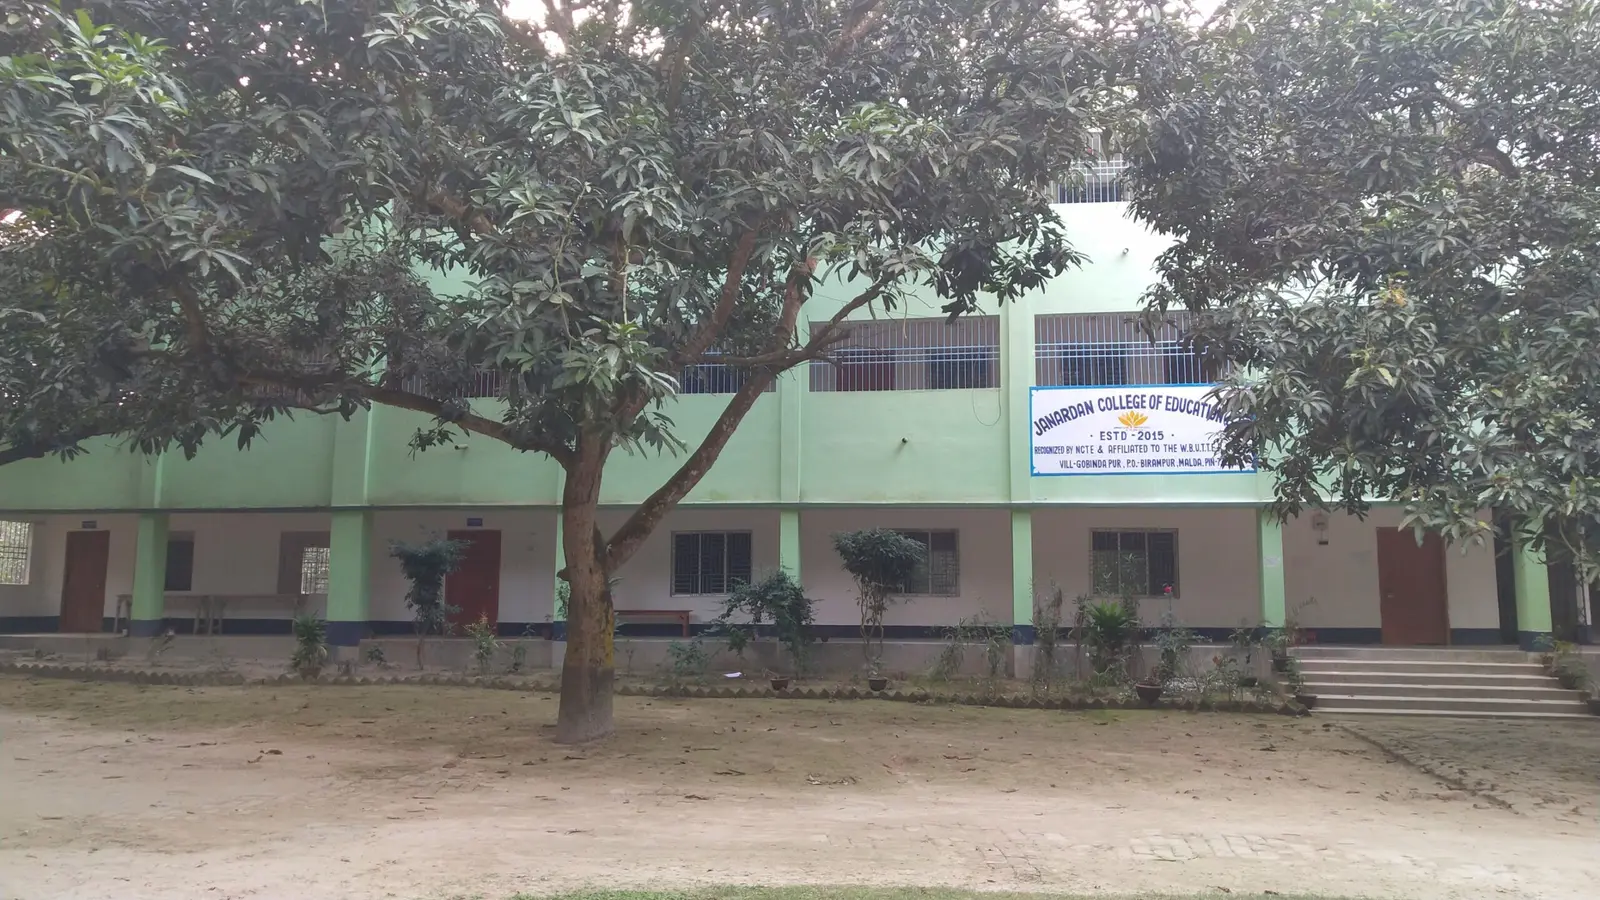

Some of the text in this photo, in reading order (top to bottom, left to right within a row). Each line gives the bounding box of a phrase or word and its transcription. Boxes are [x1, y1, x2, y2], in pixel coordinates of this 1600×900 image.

[1034, 400, 1094, 436] JANARDAN
[1098, 394, 1146, 412] COLLEGE
[1149, 394, 1162, 410] OF
[1100, 431, 1127, 440] ESTD
[1034, 446, 1065, 454] RECOGNIZED
[1066, 446, 1074, 454] BY
[1076, 445, 1094, 454] NCTE
[1097, 444, 1104, 454] &
[1108, 444, 1148, 454] AFFILIATED
[1150, 444, 1160, 452] TO
[1164, 444, 1177, 452] THE
